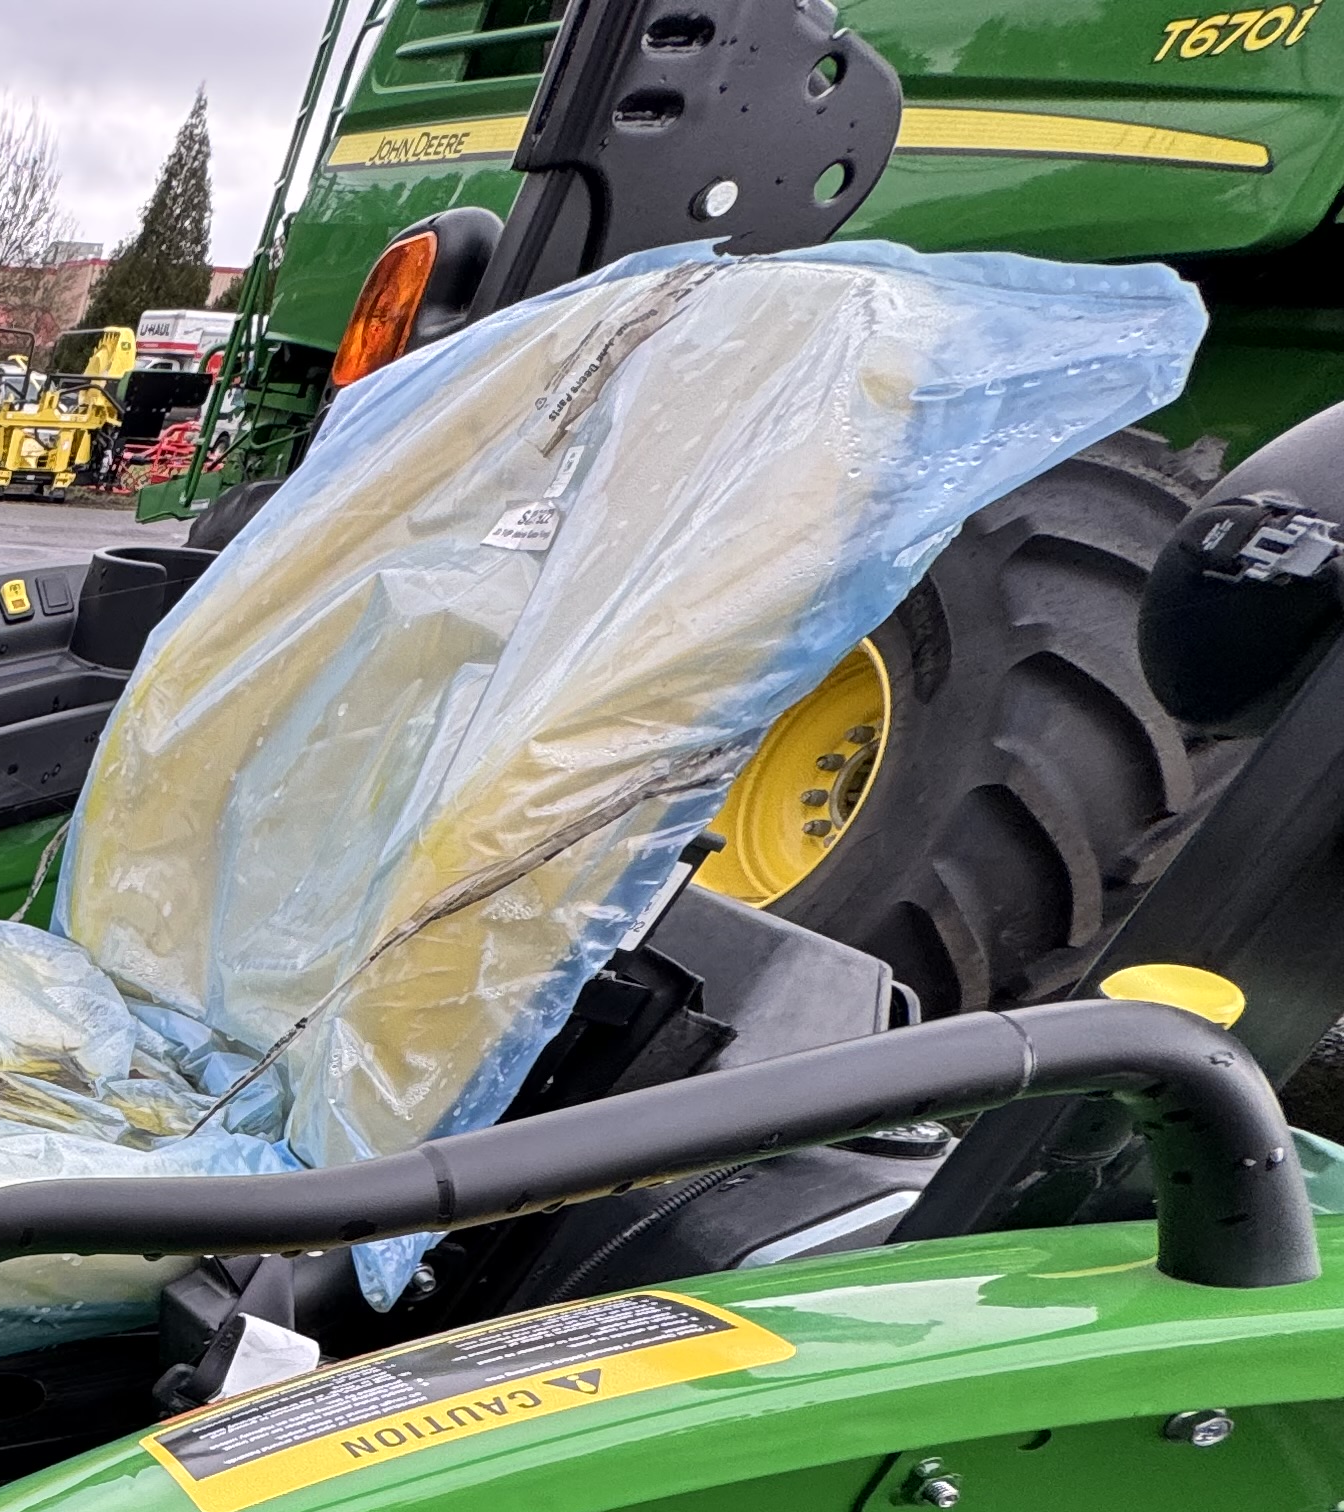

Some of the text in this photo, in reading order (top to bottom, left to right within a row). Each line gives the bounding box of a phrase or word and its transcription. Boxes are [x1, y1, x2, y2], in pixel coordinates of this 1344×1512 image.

[1153, 0, 1324, 63] T670i
[368, 131, 471, 162] JOHN DEERE
[340, 1389, 543, 1459] CAUTION
